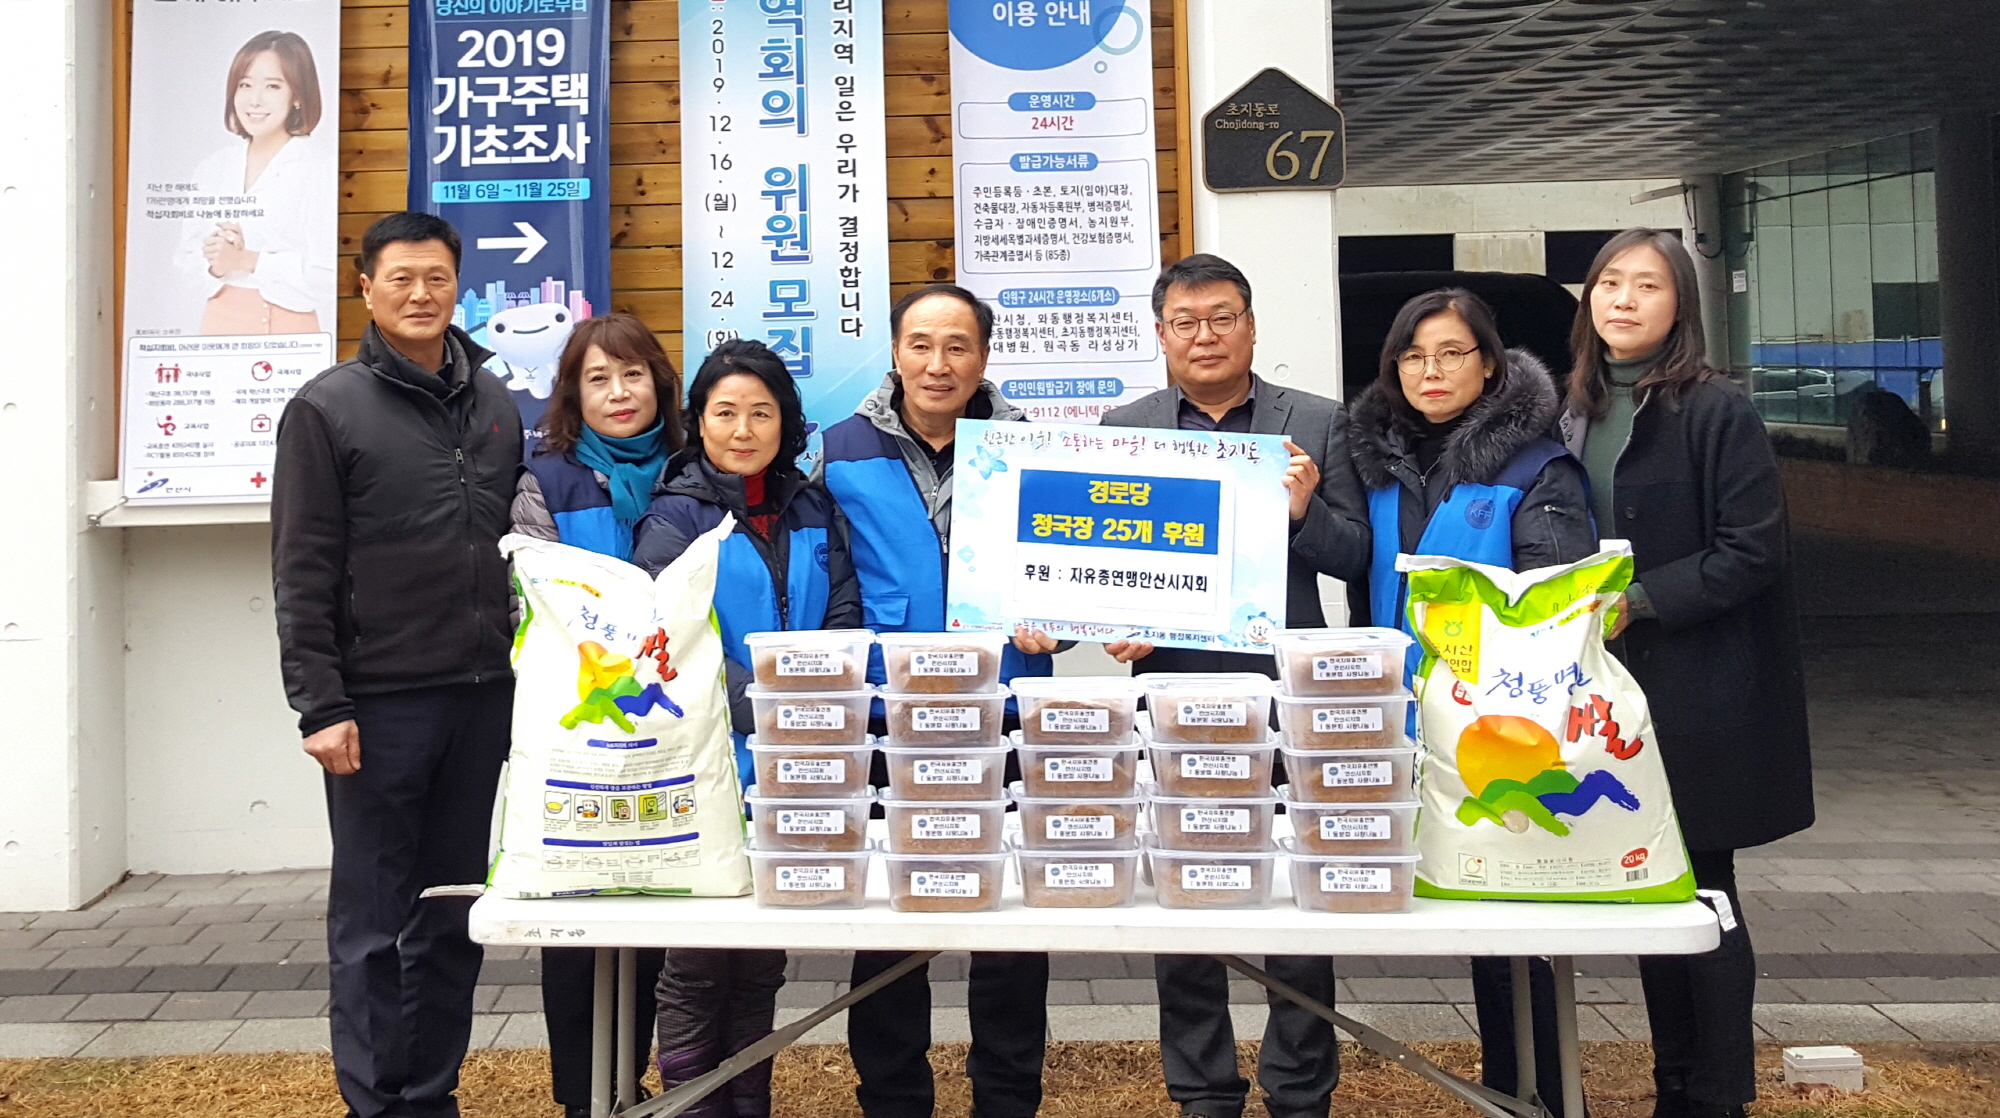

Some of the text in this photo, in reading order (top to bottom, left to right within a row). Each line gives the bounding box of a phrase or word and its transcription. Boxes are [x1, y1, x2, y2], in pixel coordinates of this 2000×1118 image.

[993, 1, 1091, 27] 이용 안내
[457, 28, 566, 68] 2019
[432, 73, 589, 118] 가구주택
[835, 76, 857, 122] 일은
[1028, 94, 1076, 108] 운영시간
[1225, 103, 1281, 118] 초지동로
[1031, 116, 1074, 131] 24시간
[1215, 119, 1280, 131] Chojidong-ro
[433, 122, 591, 167] 기초조사
[1019, 154, 1089, 169] 발급가능서류
[1265, 130, 1335, 181] 67
[836, 133, 860, 203] 우리가
[147, 183, 162, 192] 지난
[444, 184, 471, 199] 11월
[475, 183, 500, 198] 6일
[547, 181, 580, 197] 25일
[146, 210, 194, 219] 적십자회비로
[197, 210, 222, 219] 나눔에
[760, 163, 812, 263] 위원
[973, 199, 1132, 215] 건축물대장, 자동차등록원부, 병적증명서,
[974, 249, 1070, 262] 가족관계증명서 등 (85종)
[838, 216, 864, 338] 결정합니다
[1002, 289, 1116, 304] 단원구 24시간 운영장소(6개소)
[1038, 311, 1139, 325] 와동행정복지센터,
[762, 279, 816, 377] 모집
[1061, 325, 1140, 339] 초지동행정복지센터,
[1043, 340, 1081, 353] 원곡동
[1088, 339, 1139, 352] 라성상가
[1008, 381, 1117, 396] 무인민원발급기 장애 문의
[984, 430, 1015, 445] 친근한
[1063, 433, 1104, 452] 소통하는
[1113, 435, 1146, 456] 마을!
[1154, 440, 1166, 450] 더
[1172, 440, 1210, 457] 행복한
[1216, 439, 1261, 464] 초지동
[1088, 480, 1152, 506] 경로당
[1031, 513, 1205, 547] 청국장 25개 후원
[1024, 564, 1050, 582] 후원
[1070, 567, 1208, 593] 자유총연맹안산시지회
[1143, 630, 1216, 643] 초지동 행정복지센터
[634, 626, 679, 683] 쌀
[1566, 694, 1645, 761] 쌀
[1624, 851, 1646, 864] 20 kg
